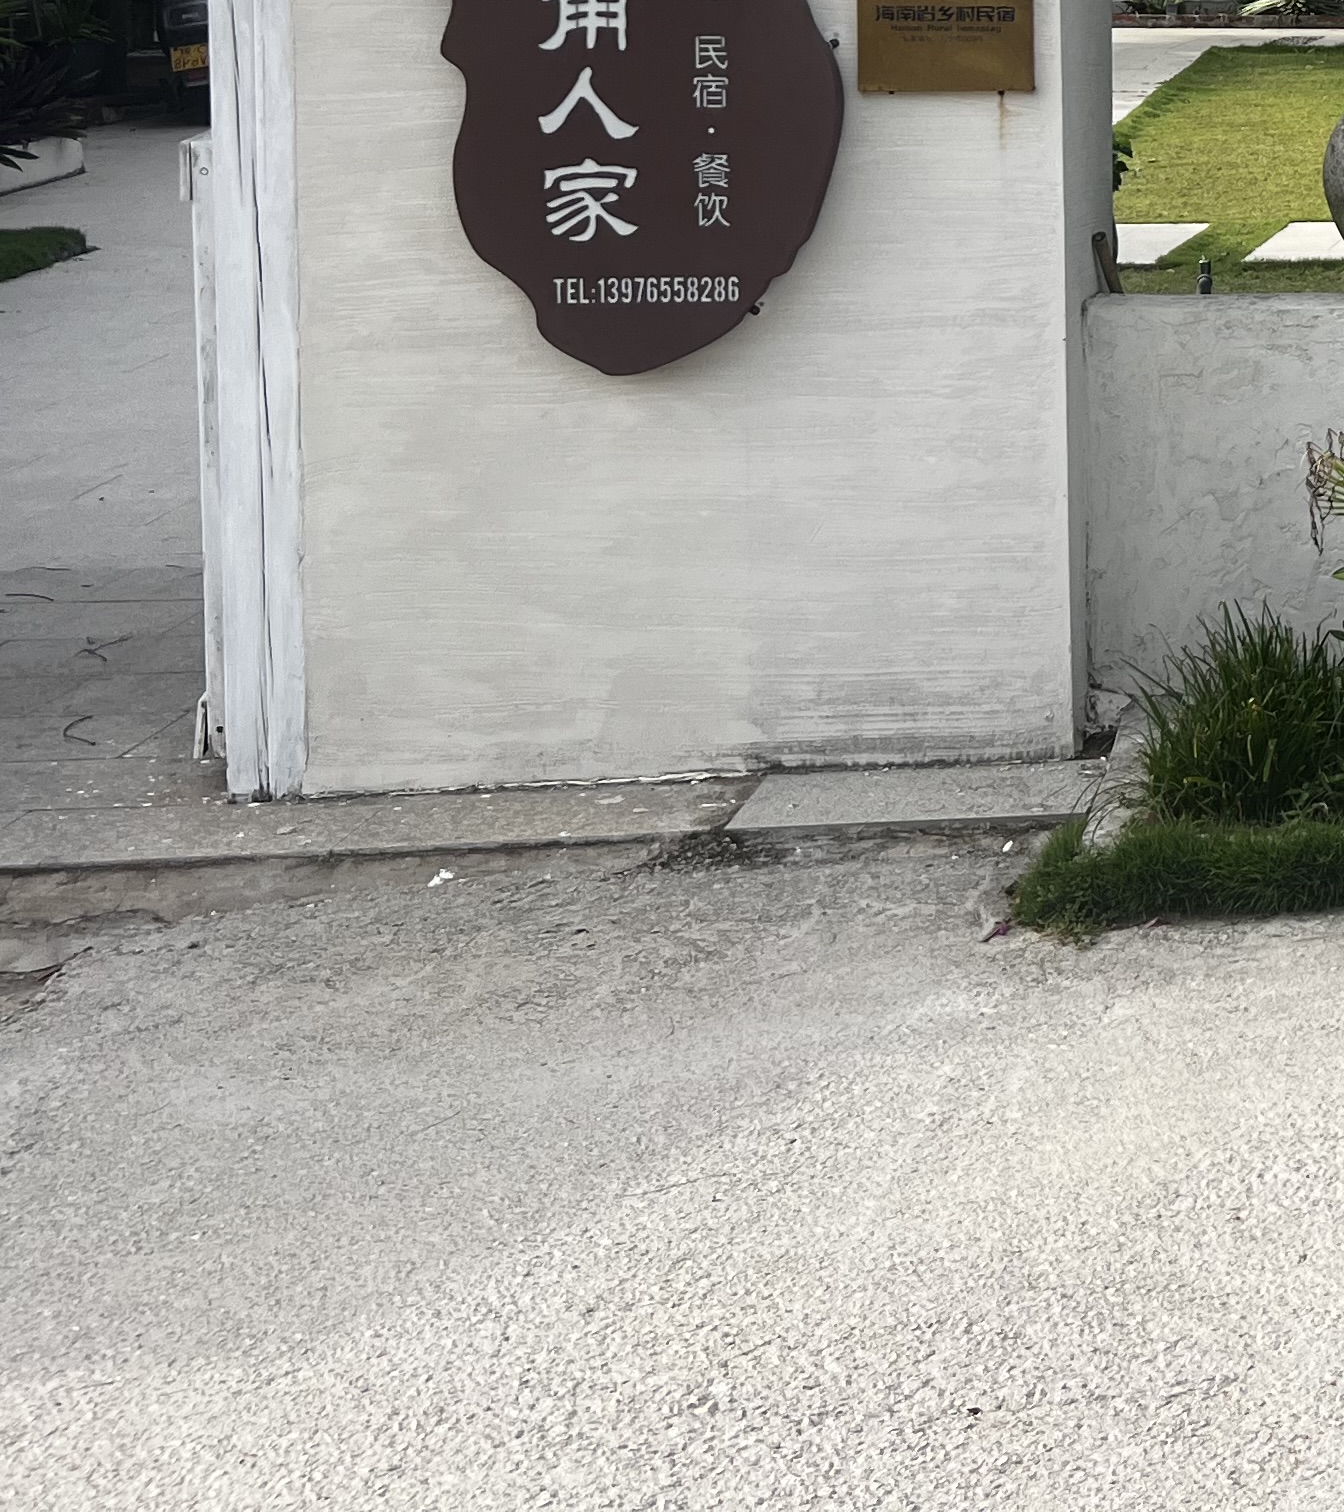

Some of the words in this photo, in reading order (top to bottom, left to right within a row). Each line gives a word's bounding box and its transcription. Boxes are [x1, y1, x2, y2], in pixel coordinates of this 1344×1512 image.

[874, 4, 1016, 22] 海南省乡村民宿
[552, 275, 740, 304] TEL:13976558286
